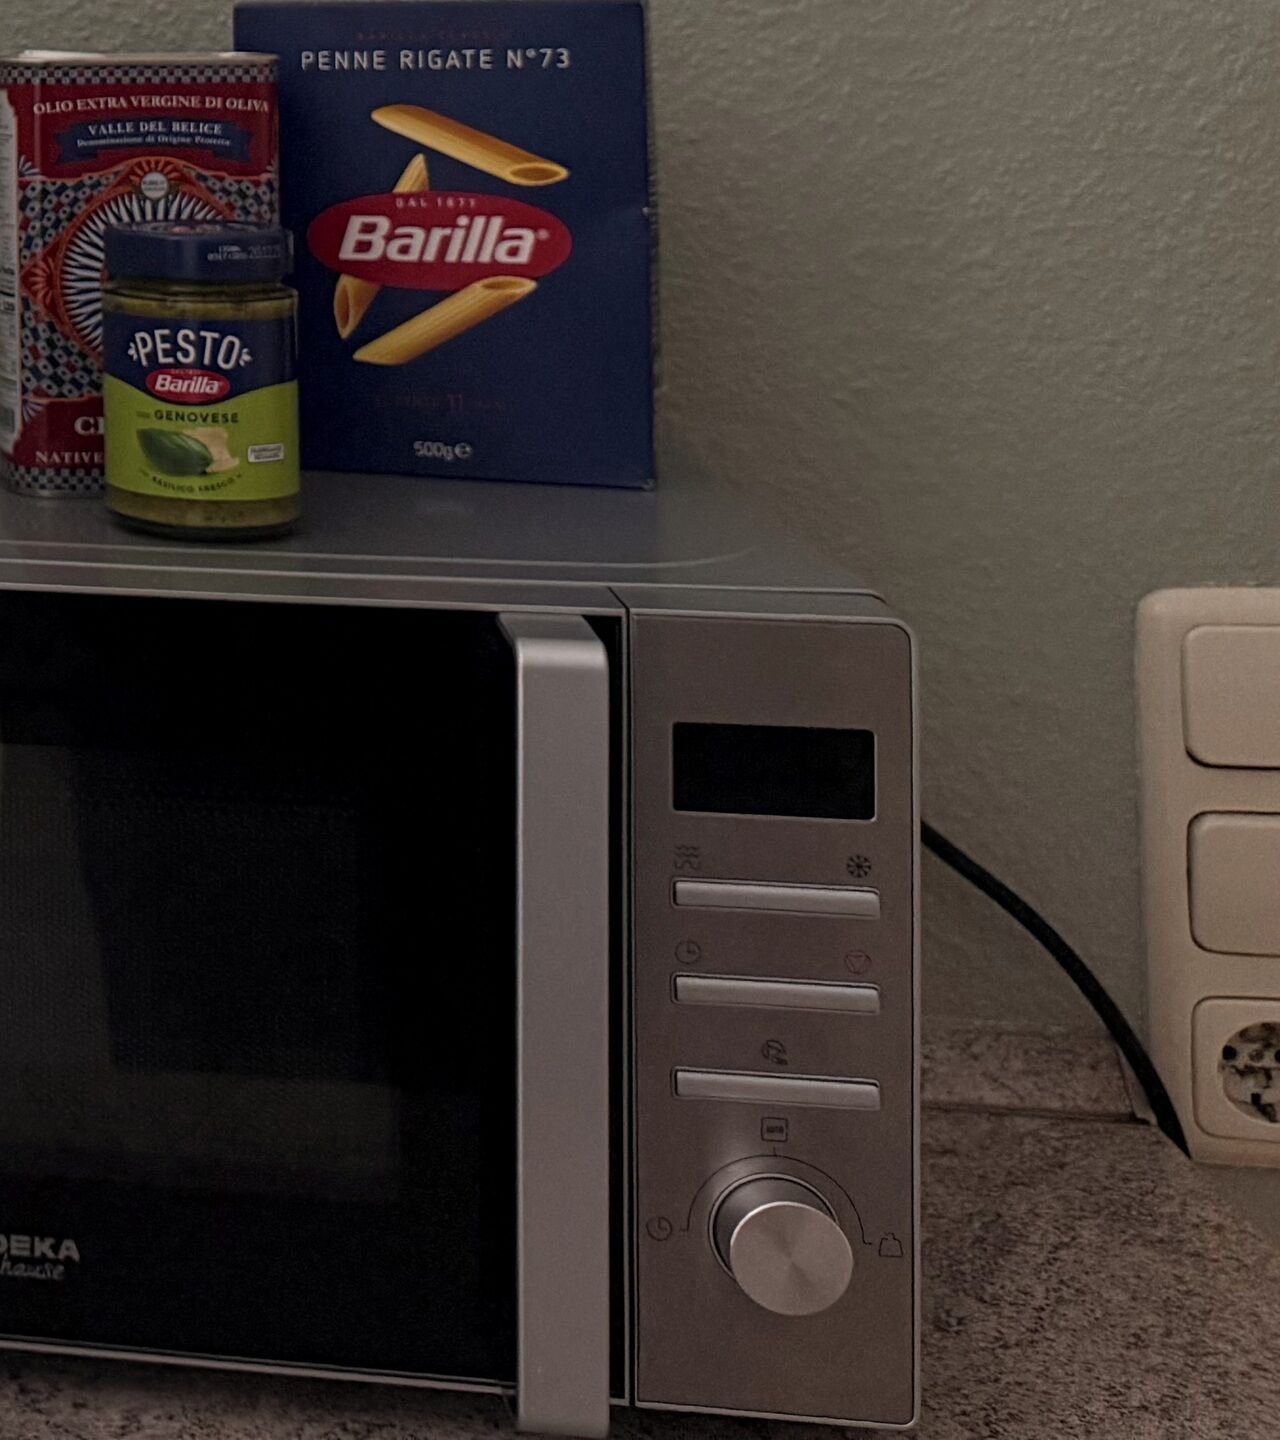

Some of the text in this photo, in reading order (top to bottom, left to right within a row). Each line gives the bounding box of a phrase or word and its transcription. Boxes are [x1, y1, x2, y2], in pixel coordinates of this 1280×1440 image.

[300, 49, 387, 71] PENNE
[399, 48, 494, 71] RIGATE
[33, 94, 270, 115] OLIO EXTRA VERGINE DI OLIVA
[87, 120, 223, 136] VALLE DEL BELICE
[394, 197, 428, 209] DAL
[338, 215, 536, 265] Barilla
[134, 328, 241, 370] PESTO
[154, 374, 220, 395] Barilla
[153, 409, 240, 424] GENOVESE
